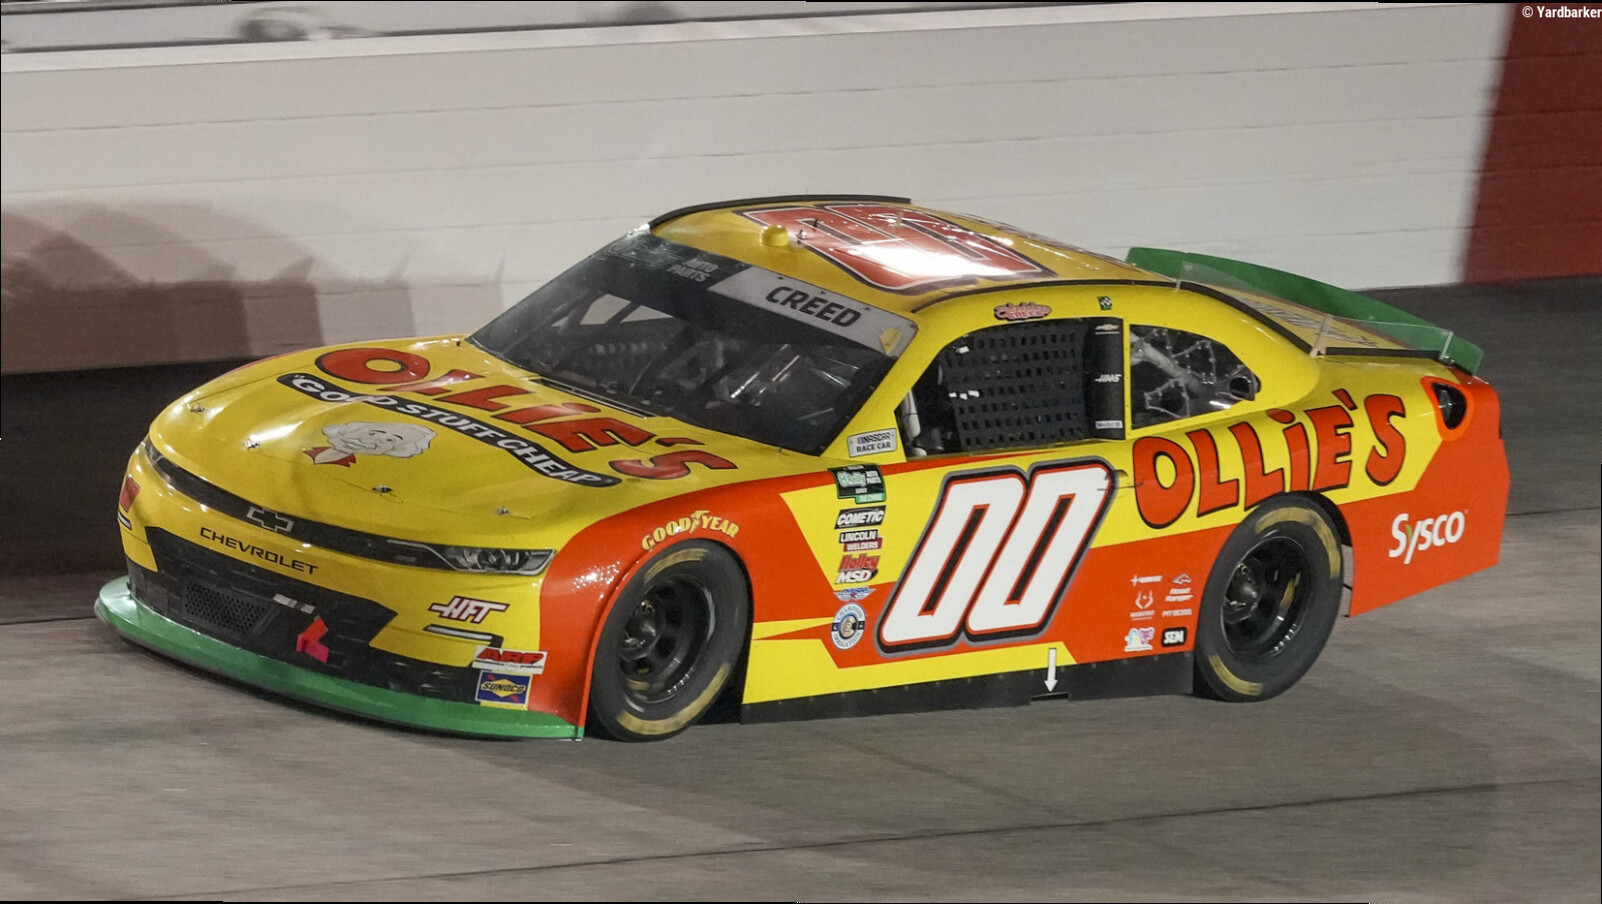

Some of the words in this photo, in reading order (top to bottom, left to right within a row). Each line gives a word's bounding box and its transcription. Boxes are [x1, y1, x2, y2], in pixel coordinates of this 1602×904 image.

[765, 286, 862, 329] CREED
[396, 403, 504, 440] STUFF
[856, 444, 876, 452] RACE
[837, 510, 884, 525] COMETIC
[840, 531, 877, 543] LINCOLN
[200, 527, 319, 576] CHEVROLET
[873, 455, 1118, 658] 00
[834, 570, 873, 585] MSD
[476, 648, 545, 664] ARP
[482, 682, 525, 693] SUNOCO
